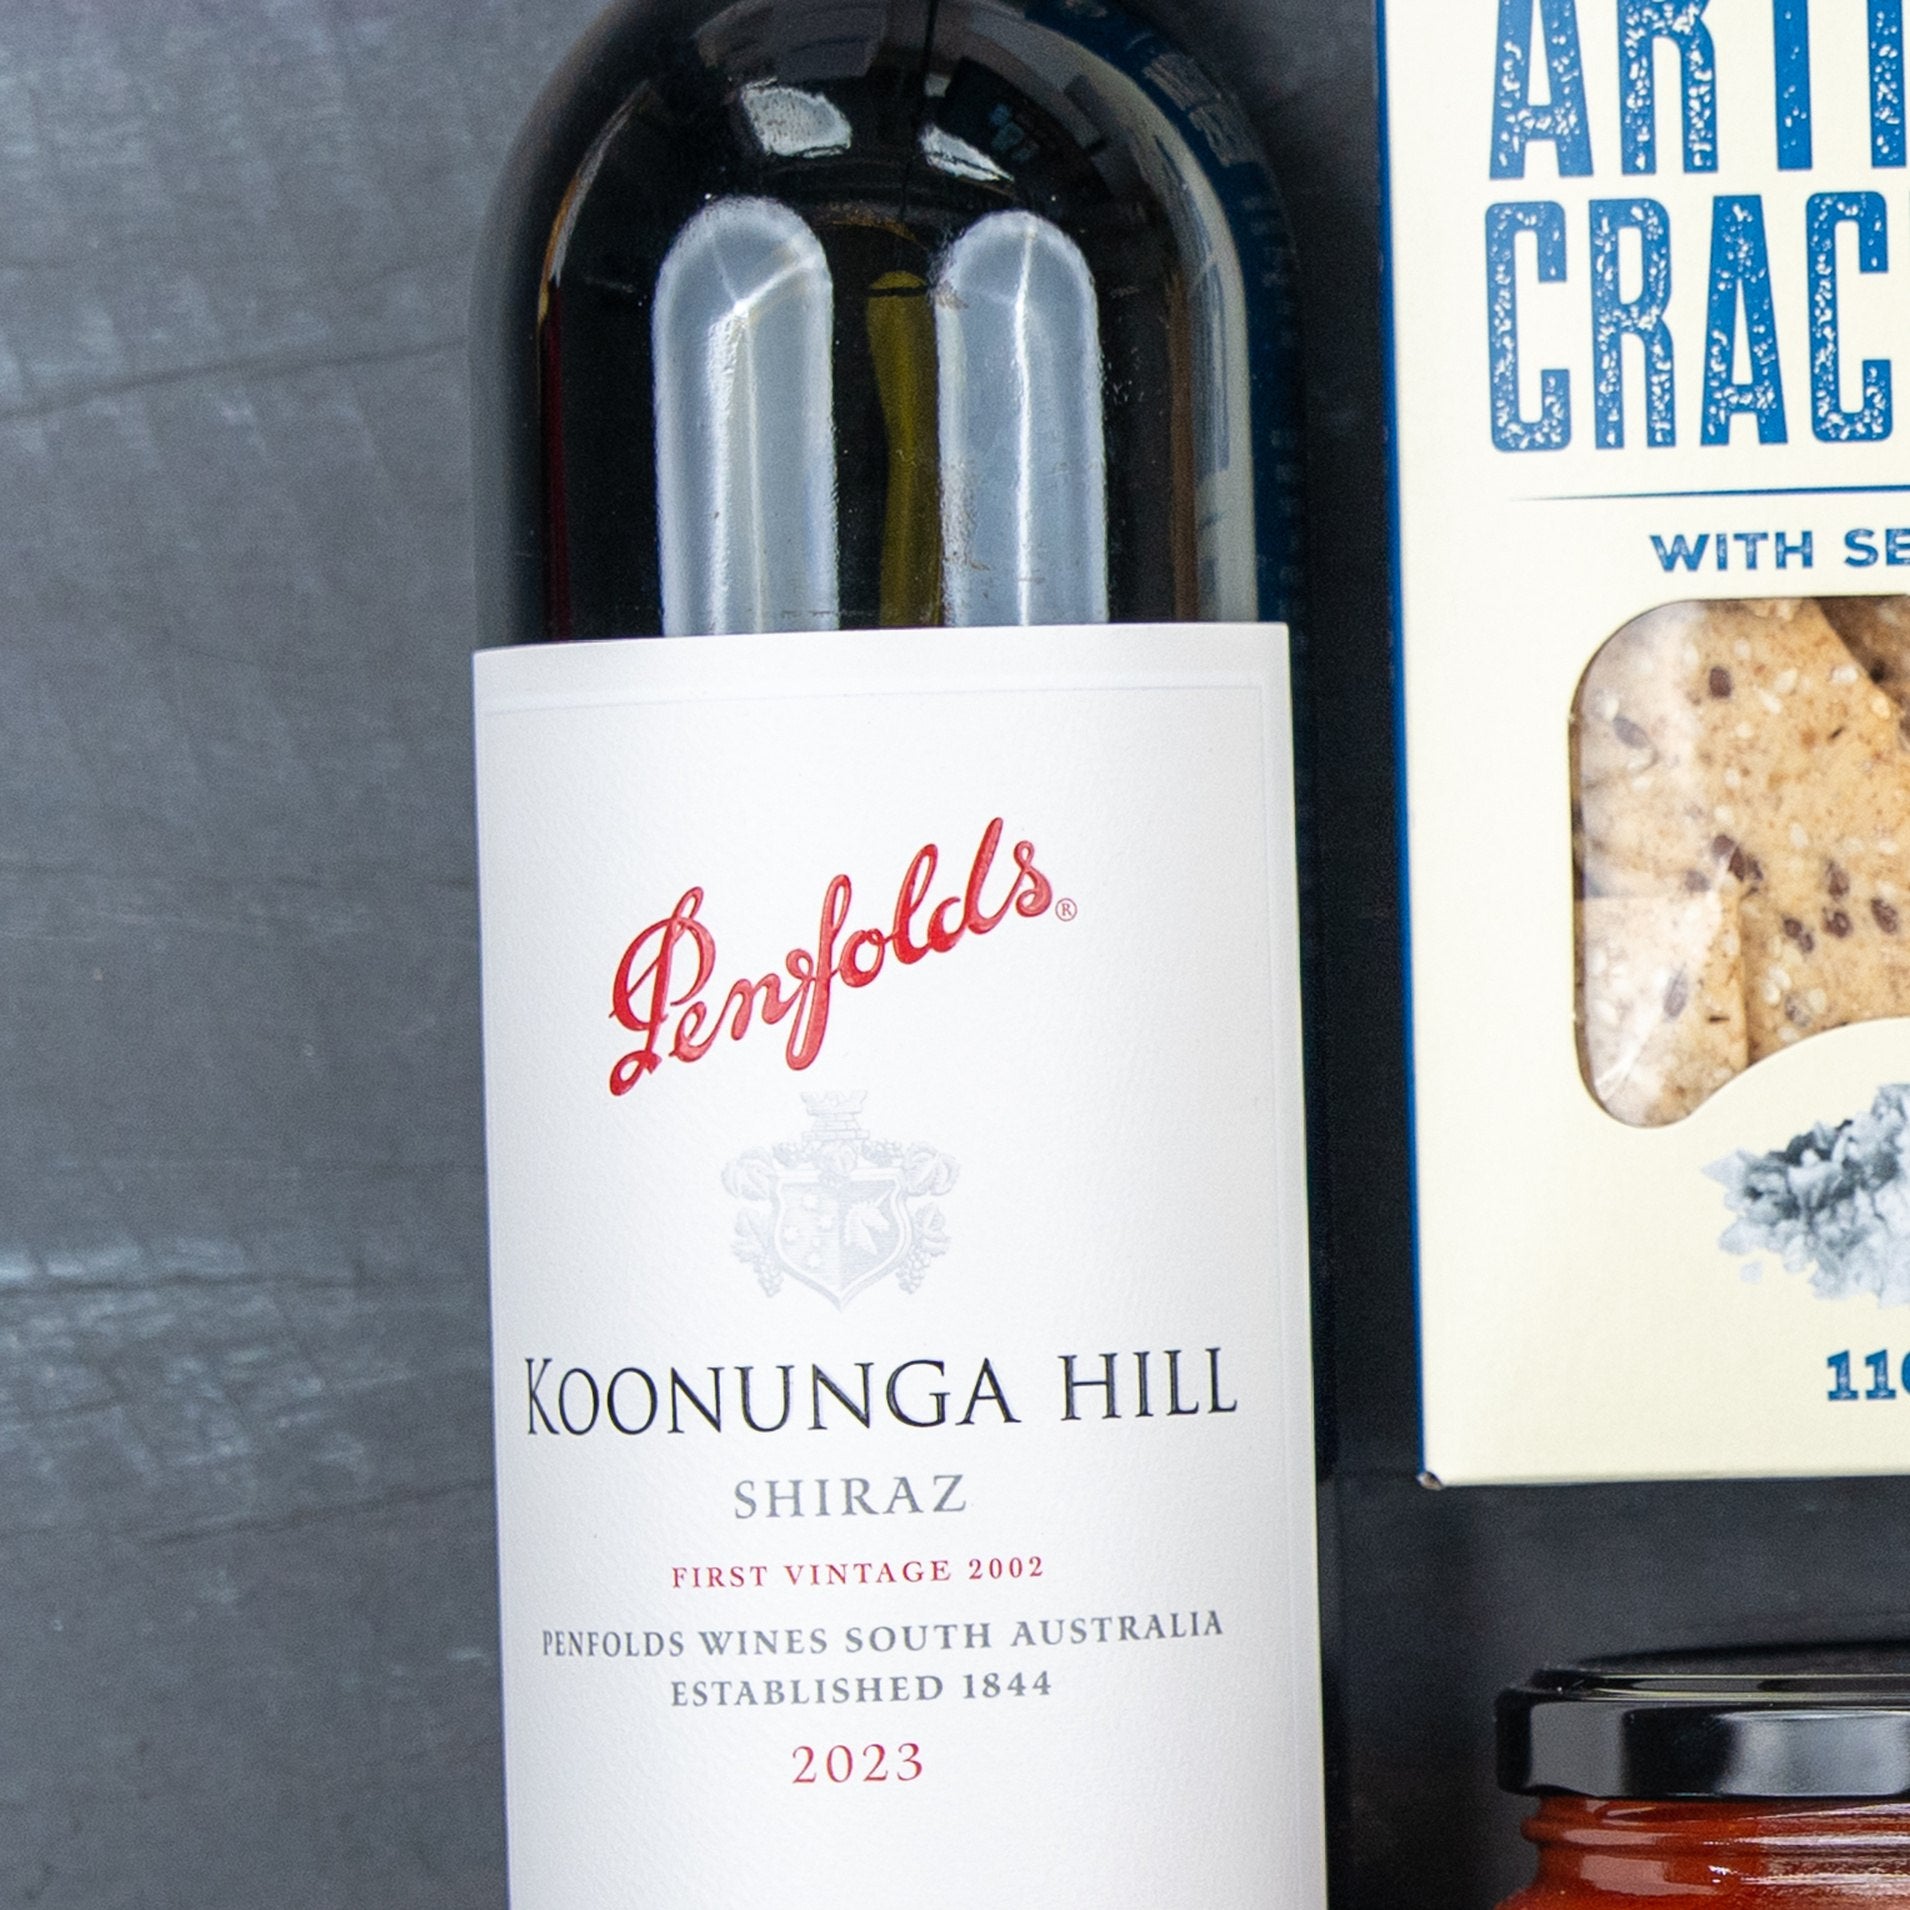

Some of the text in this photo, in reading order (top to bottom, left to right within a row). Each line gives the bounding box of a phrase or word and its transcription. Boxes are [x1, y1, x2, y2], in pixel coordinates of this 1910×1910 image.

[1485, 191, 1910, 452] CRAC
[1650, 528, 1910, 571] WITH SE
[609, 817, 1053, 1097] Penfolds
[525, 1347, 1238, 1435] KOONUNGA HILL
[735, 1474, 967, 1520] SHIRAZ
[672, 1556, 1043, 1588] FIRST VINTAGE 2002
[542, 1610, 1224, 1658] PENFOLDS WINES SOUTH AUSTRALIA
[672, 1671, 1052, 1706] ESTABLISHED 1844
[793, 1743, 923, 1784] 2023
